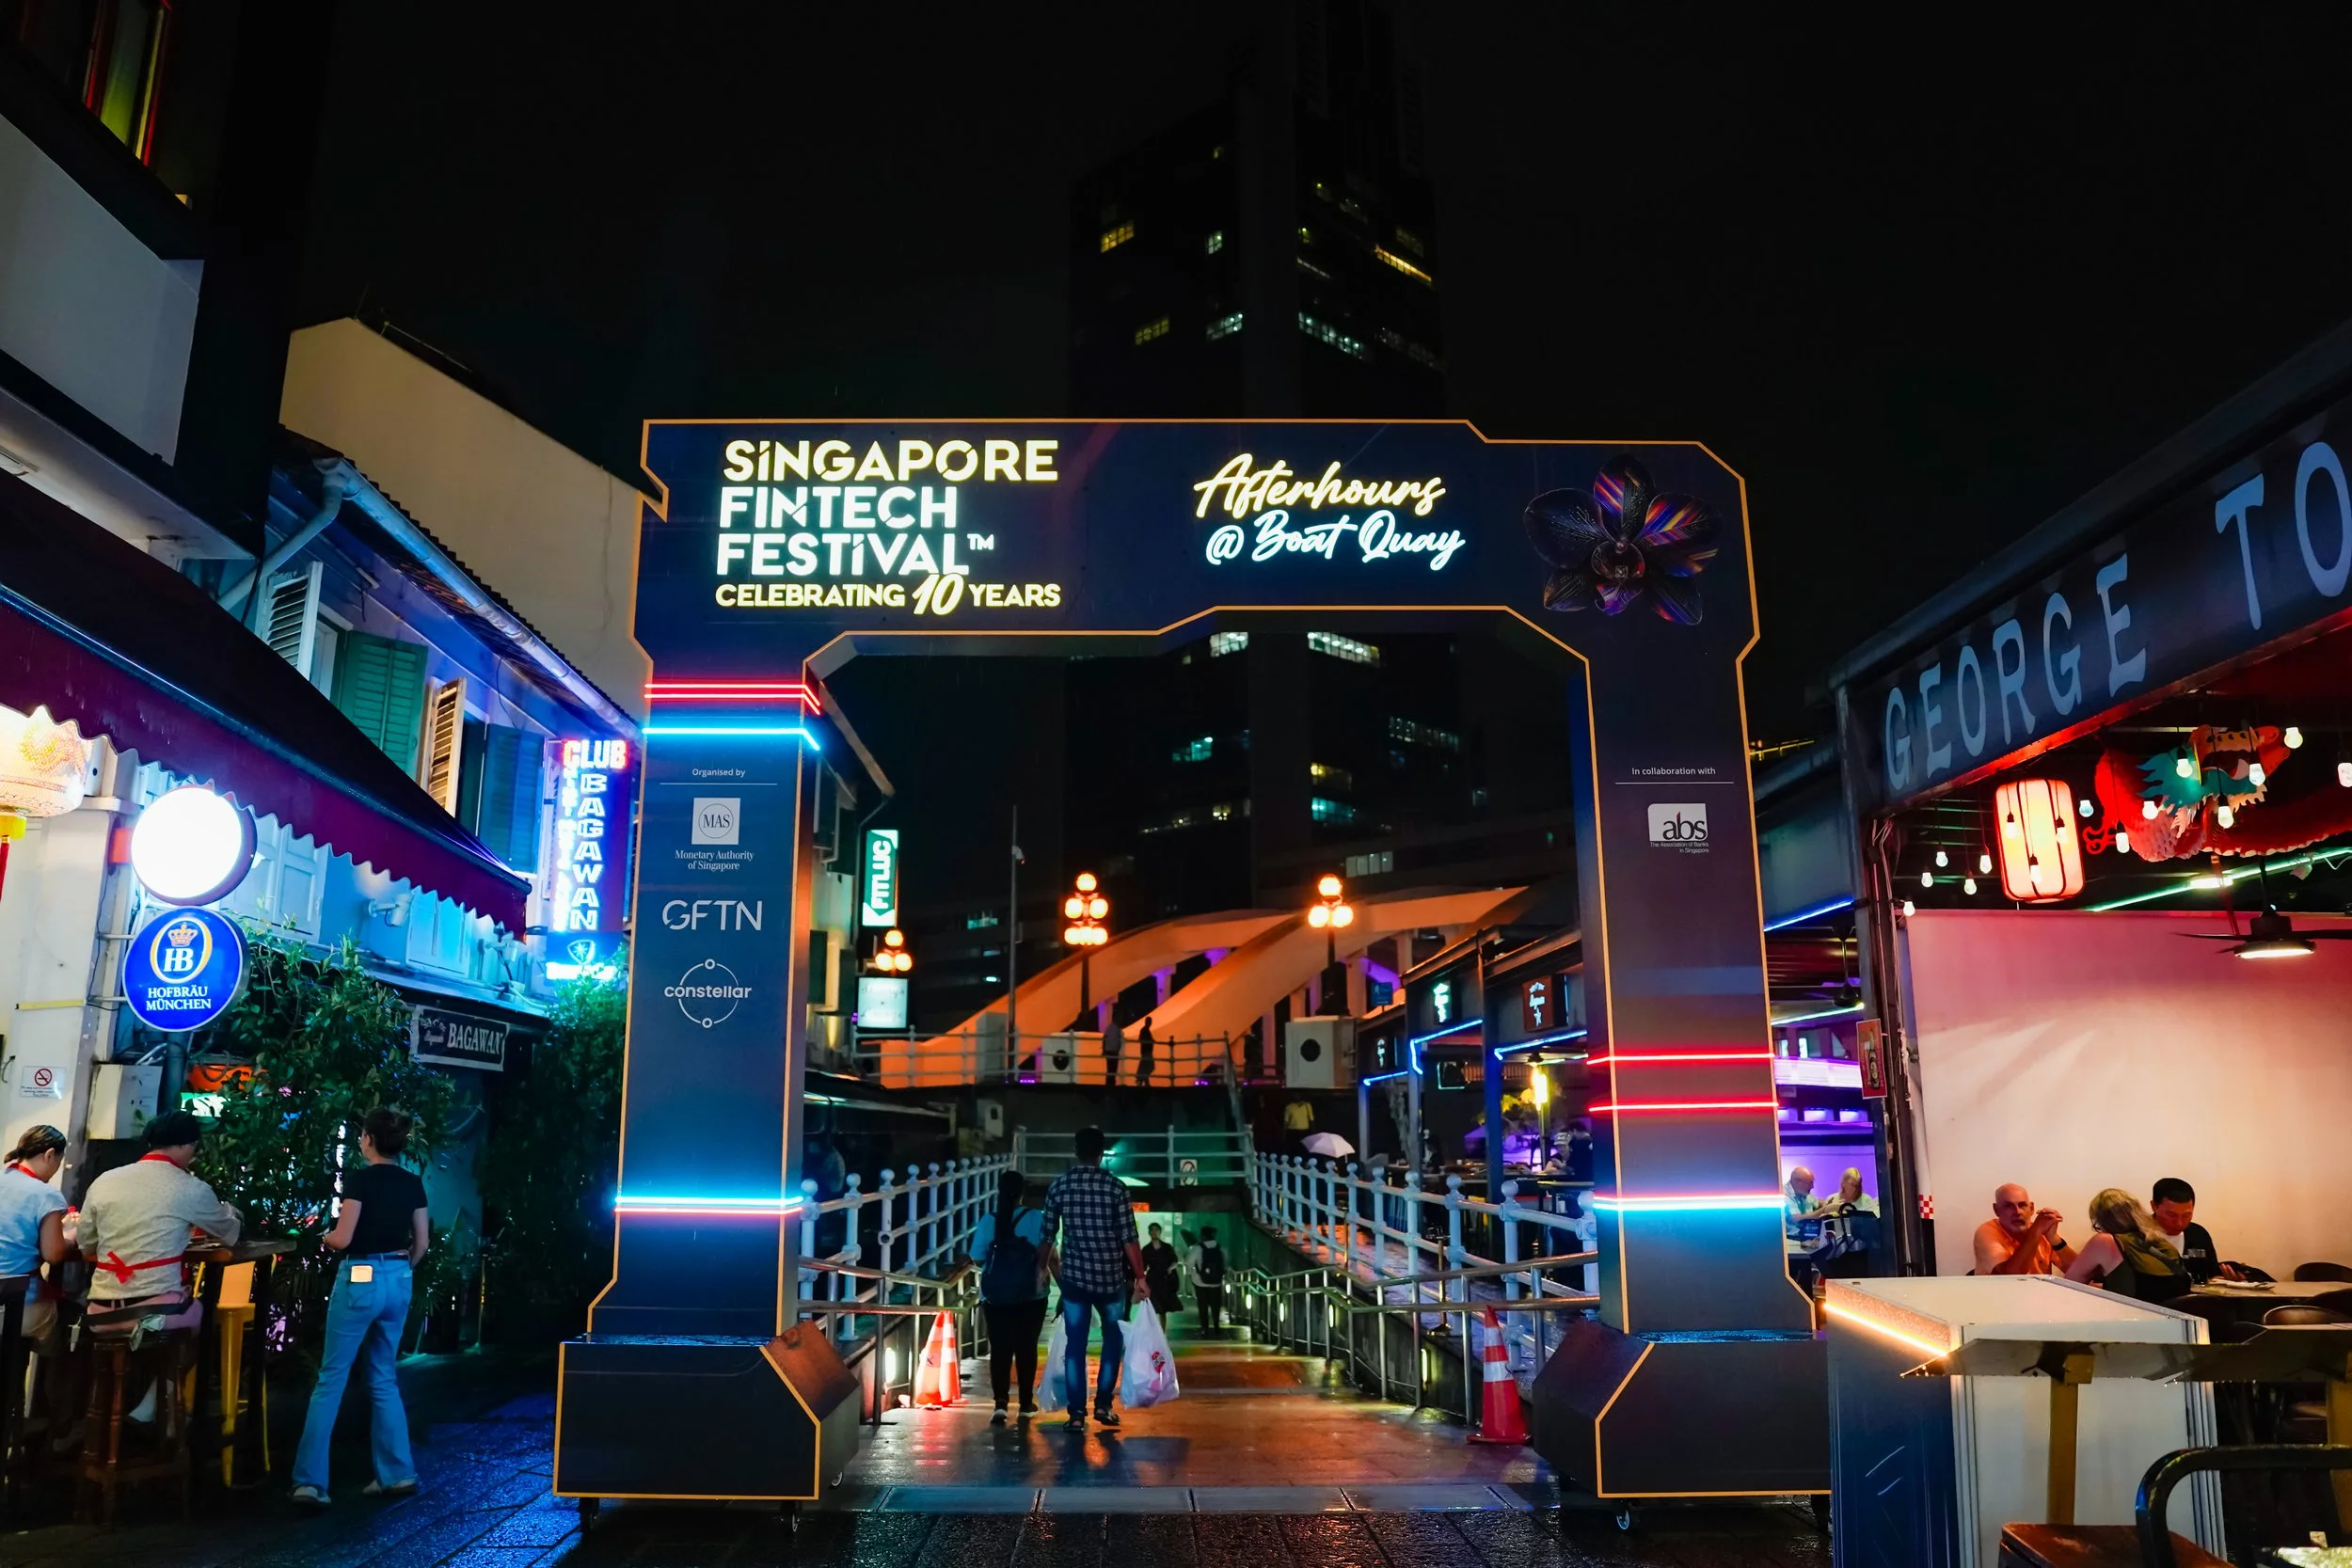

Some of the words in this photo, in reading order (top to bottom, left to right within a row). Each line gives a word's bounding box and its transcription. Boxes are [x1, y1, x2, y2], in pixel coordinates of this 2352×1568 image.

[723, 439, 1058, 481] SINGAPORE
[1193, 452, 1446, 519] Afterhours
[719, 486, 958, 528] FINTECH
[1205, 524, 1245, 565] @
[1251, 510, 1359, 562] Boat
[1358, 510, 1466, 570] Quay
[715, 583, 905, 608] CELEBRATING
[912, 572, 964, 615] 10
[968, 583, 1061, 607] YEARS
[1884, 552, 2147, 791] GEORGE
[2215, 441, 2352, 630] TO
[563, 739, 628, 769] CLUB
[691, 768, 734, 779] Organised
[736, 768, 746, 779] by
[1642, 767, 1696, 775] collaboration
[1697, 767, 1716, 775] with
[703, 814, 730, 829] MAS
[1662, 811, 1708, 840] abs
[569, 773, 607, 930] BAGAWAN
[675, 849, 715, 861] Monetary
[715, 849, 755, 862] Authority
[688, 861, 697, 870] of
[697, 861, 740, 873] Singapore
[662, 899, 763, 931] GFTN
[146, 998, 212, 1011] MÜNCHEN
[148, 984, 208, 999] HOFBRÄU
[664, 985, 753, 999] constellar
[447, 1022, 504, 1054] BAGAWAN
